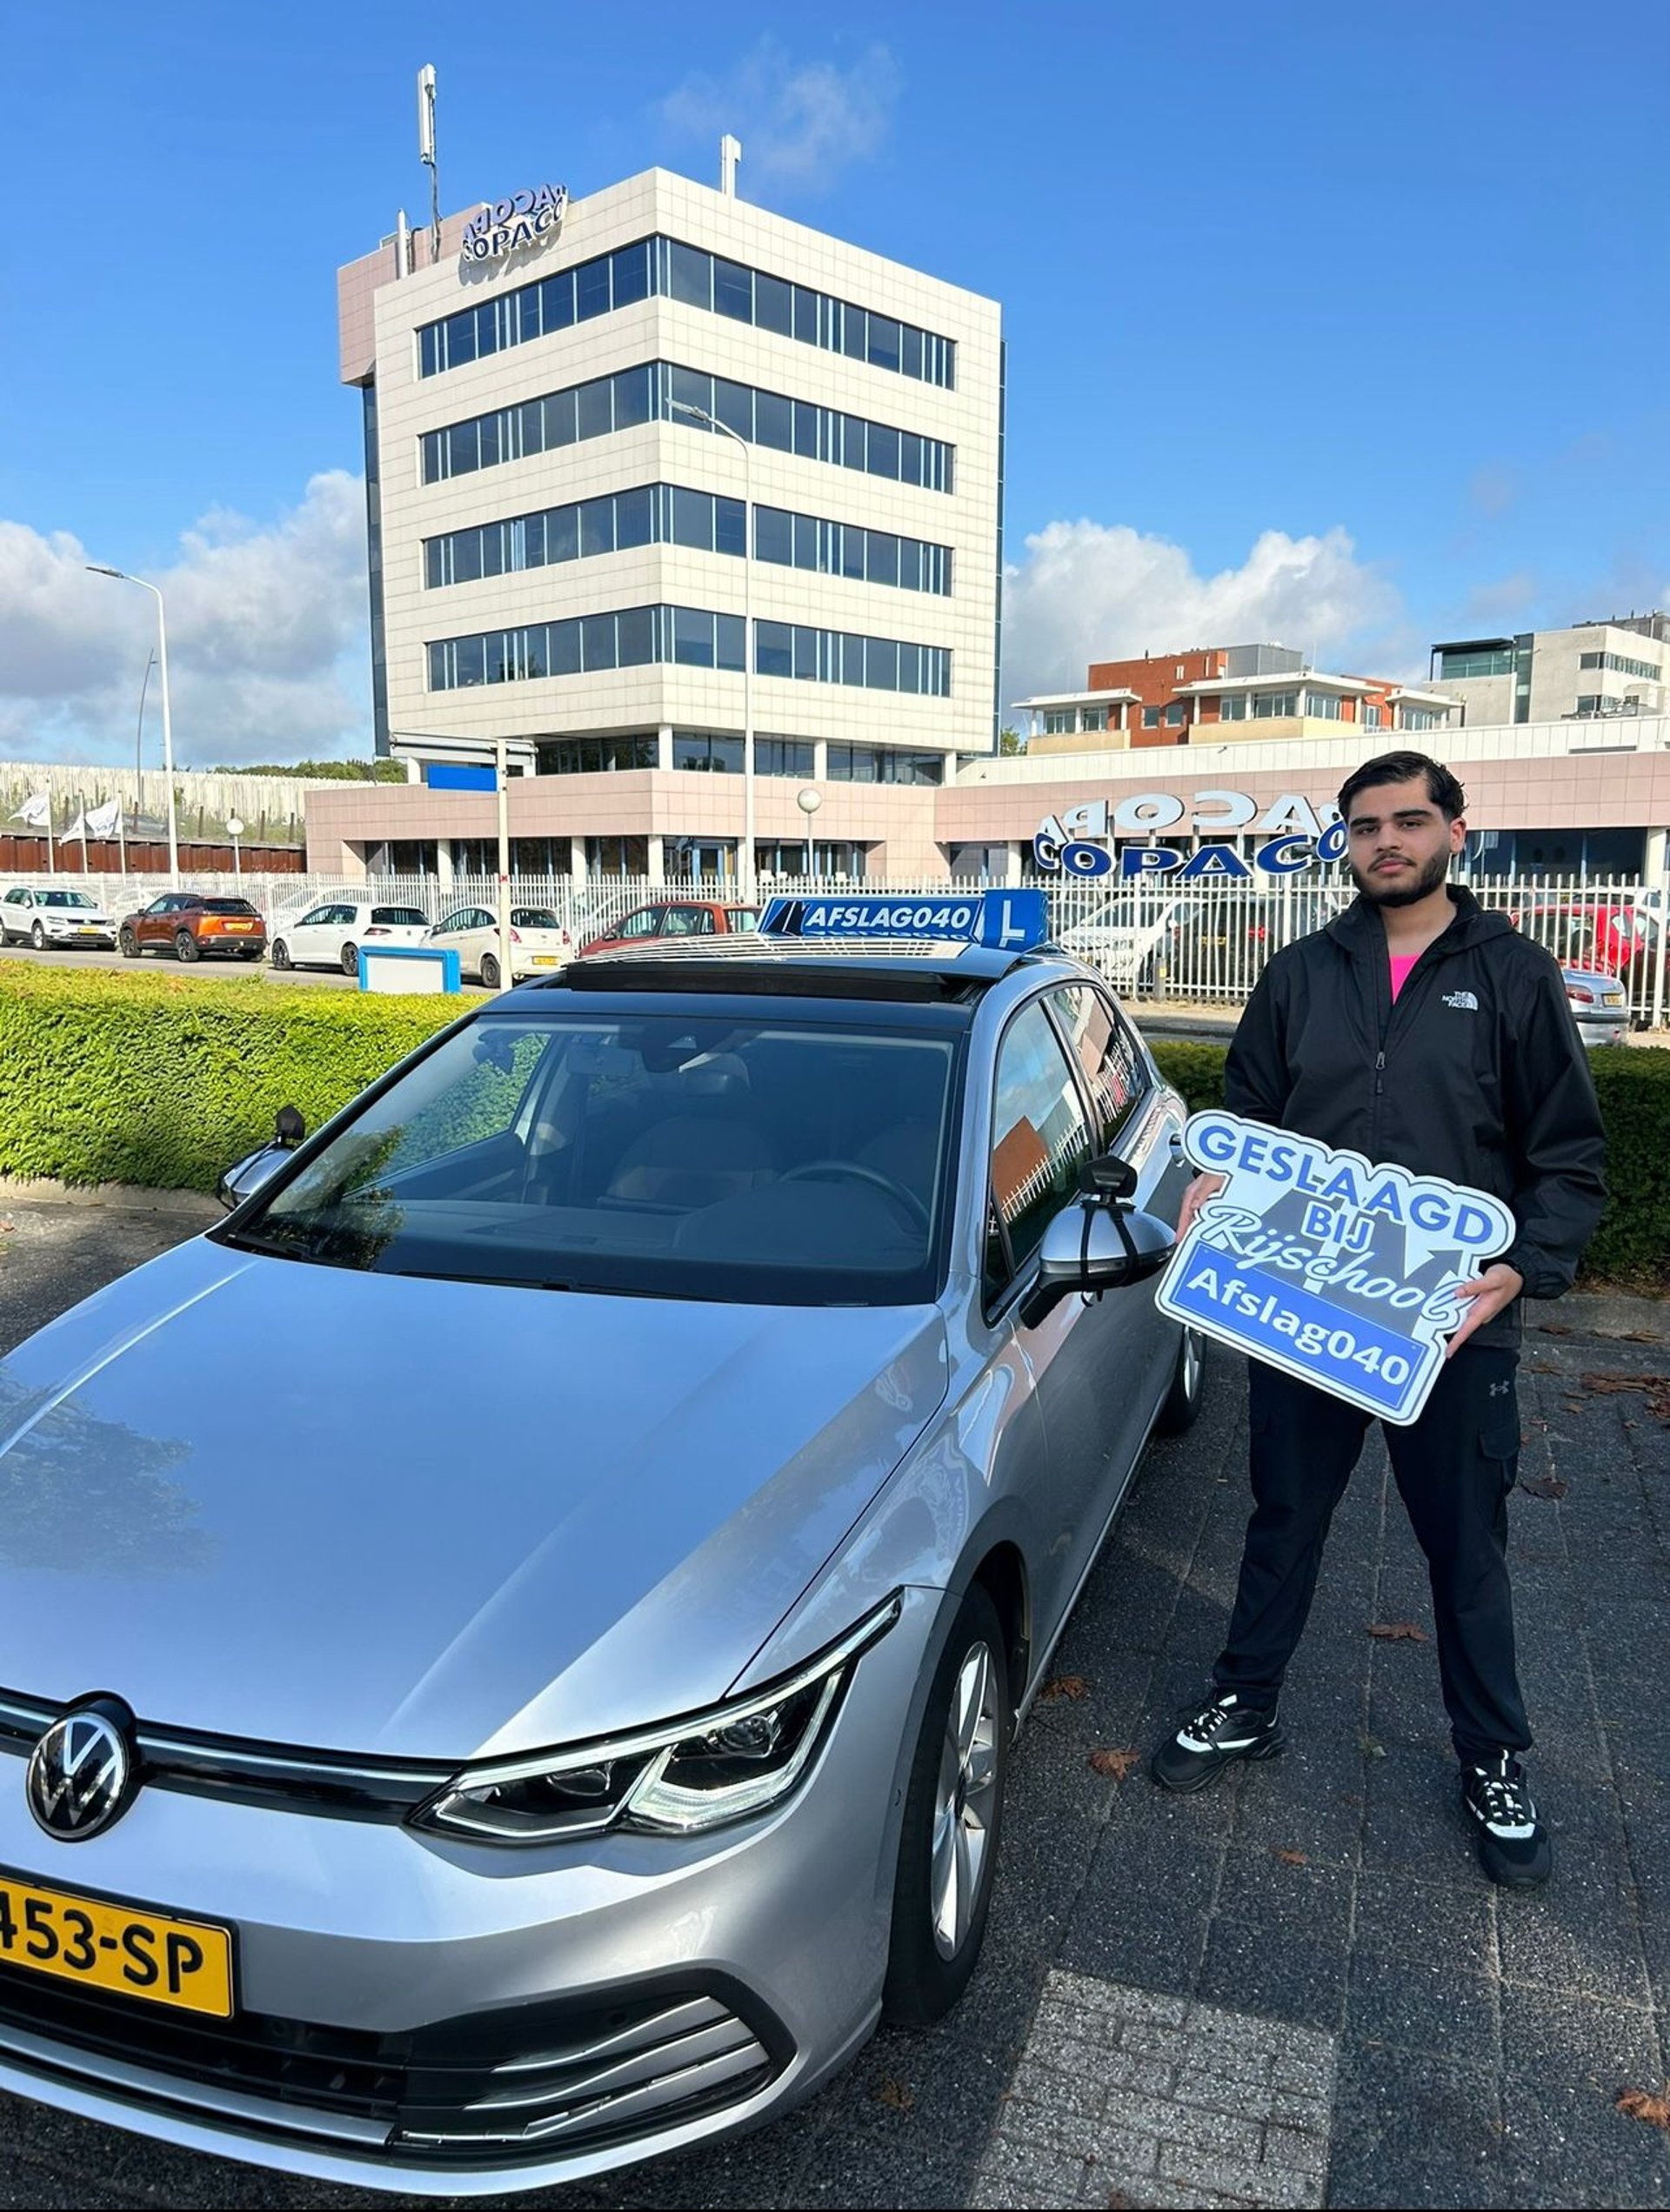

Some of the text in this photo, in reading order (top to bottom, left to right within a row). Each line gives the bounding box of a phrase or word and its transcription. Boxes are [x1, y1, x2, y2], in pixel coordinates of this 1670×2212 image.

[1033, 820, 1349, 881] COPACO
[805, 906, 972, 929] AFSLAG040
[1002, 899, 1025, 938] L
[1198, 1125, 1494, 1245] GESLAAGD
[1306, 1206, 1372, 1250] BIJ
[1199, 1205, 1470, 1322] Rijschool
[1186, 1266, 1411, 1386] Afslag040
